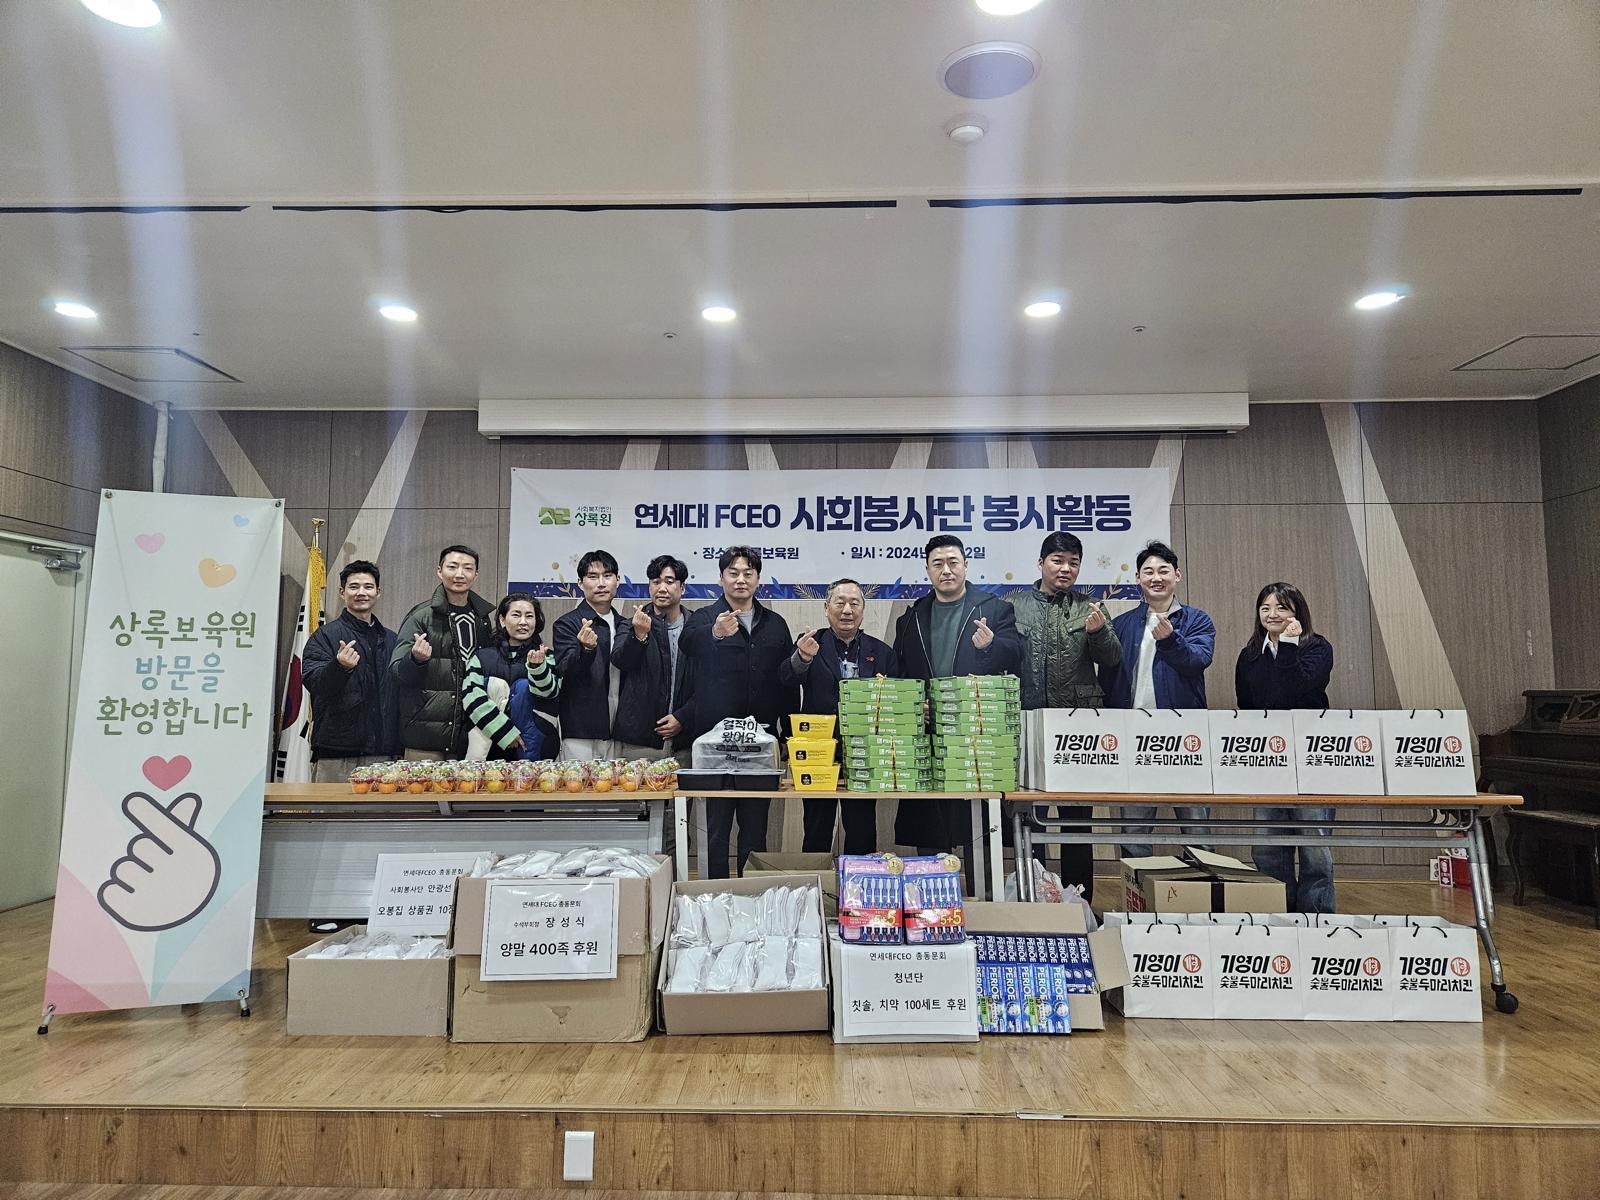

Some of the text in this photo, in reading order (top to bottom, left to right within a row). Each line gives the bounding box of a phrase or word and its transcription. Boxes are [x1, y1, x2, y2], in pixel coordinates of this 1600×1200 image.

[574, 512, 612, 527] 상록원
[634, 494, 1132, 532] 연세대 FCEO 사회봉사단 봉사활동
[851, 546, 875, 559] 일시
[109, 609, 257, 650] 상록보육원
[135, 651, 225, 693] 방문을
[96, 695, 253, 736] 환영합니다
[1055, 734, 1101, 751] 기영이
[1135, 735, 1183, 752] 기영이
[1221, 736, 1268, 753] 기영이
[1305, 735, 1353, 753] 기영이
[1395, 736, 1443, 754] 기영이
[390, 886, 424, 894] 사회봉사단
[377, 905, 404, 916] 오봉집
[408, 904, 434, 916] 상품권
[940, 909, 962, 925] 5+5
[500, 941, 599, 957] 양말 400족 후원
[869, 952, 912, 961] 연세대FCEO
[1132, 953, 1182, 973] 기영이
[1220, 954, 1270, 974] 기영이
[1311, 956, 1362, 976] 기영이
[1399, 956, 1449, 976] 기영이
[894, 972, 924, 984] 청년단
[880, 999, 899, 1011] 치약
[904, 999, 942, 1011] 100세트
[946, 998, 967, 1011] 후원
